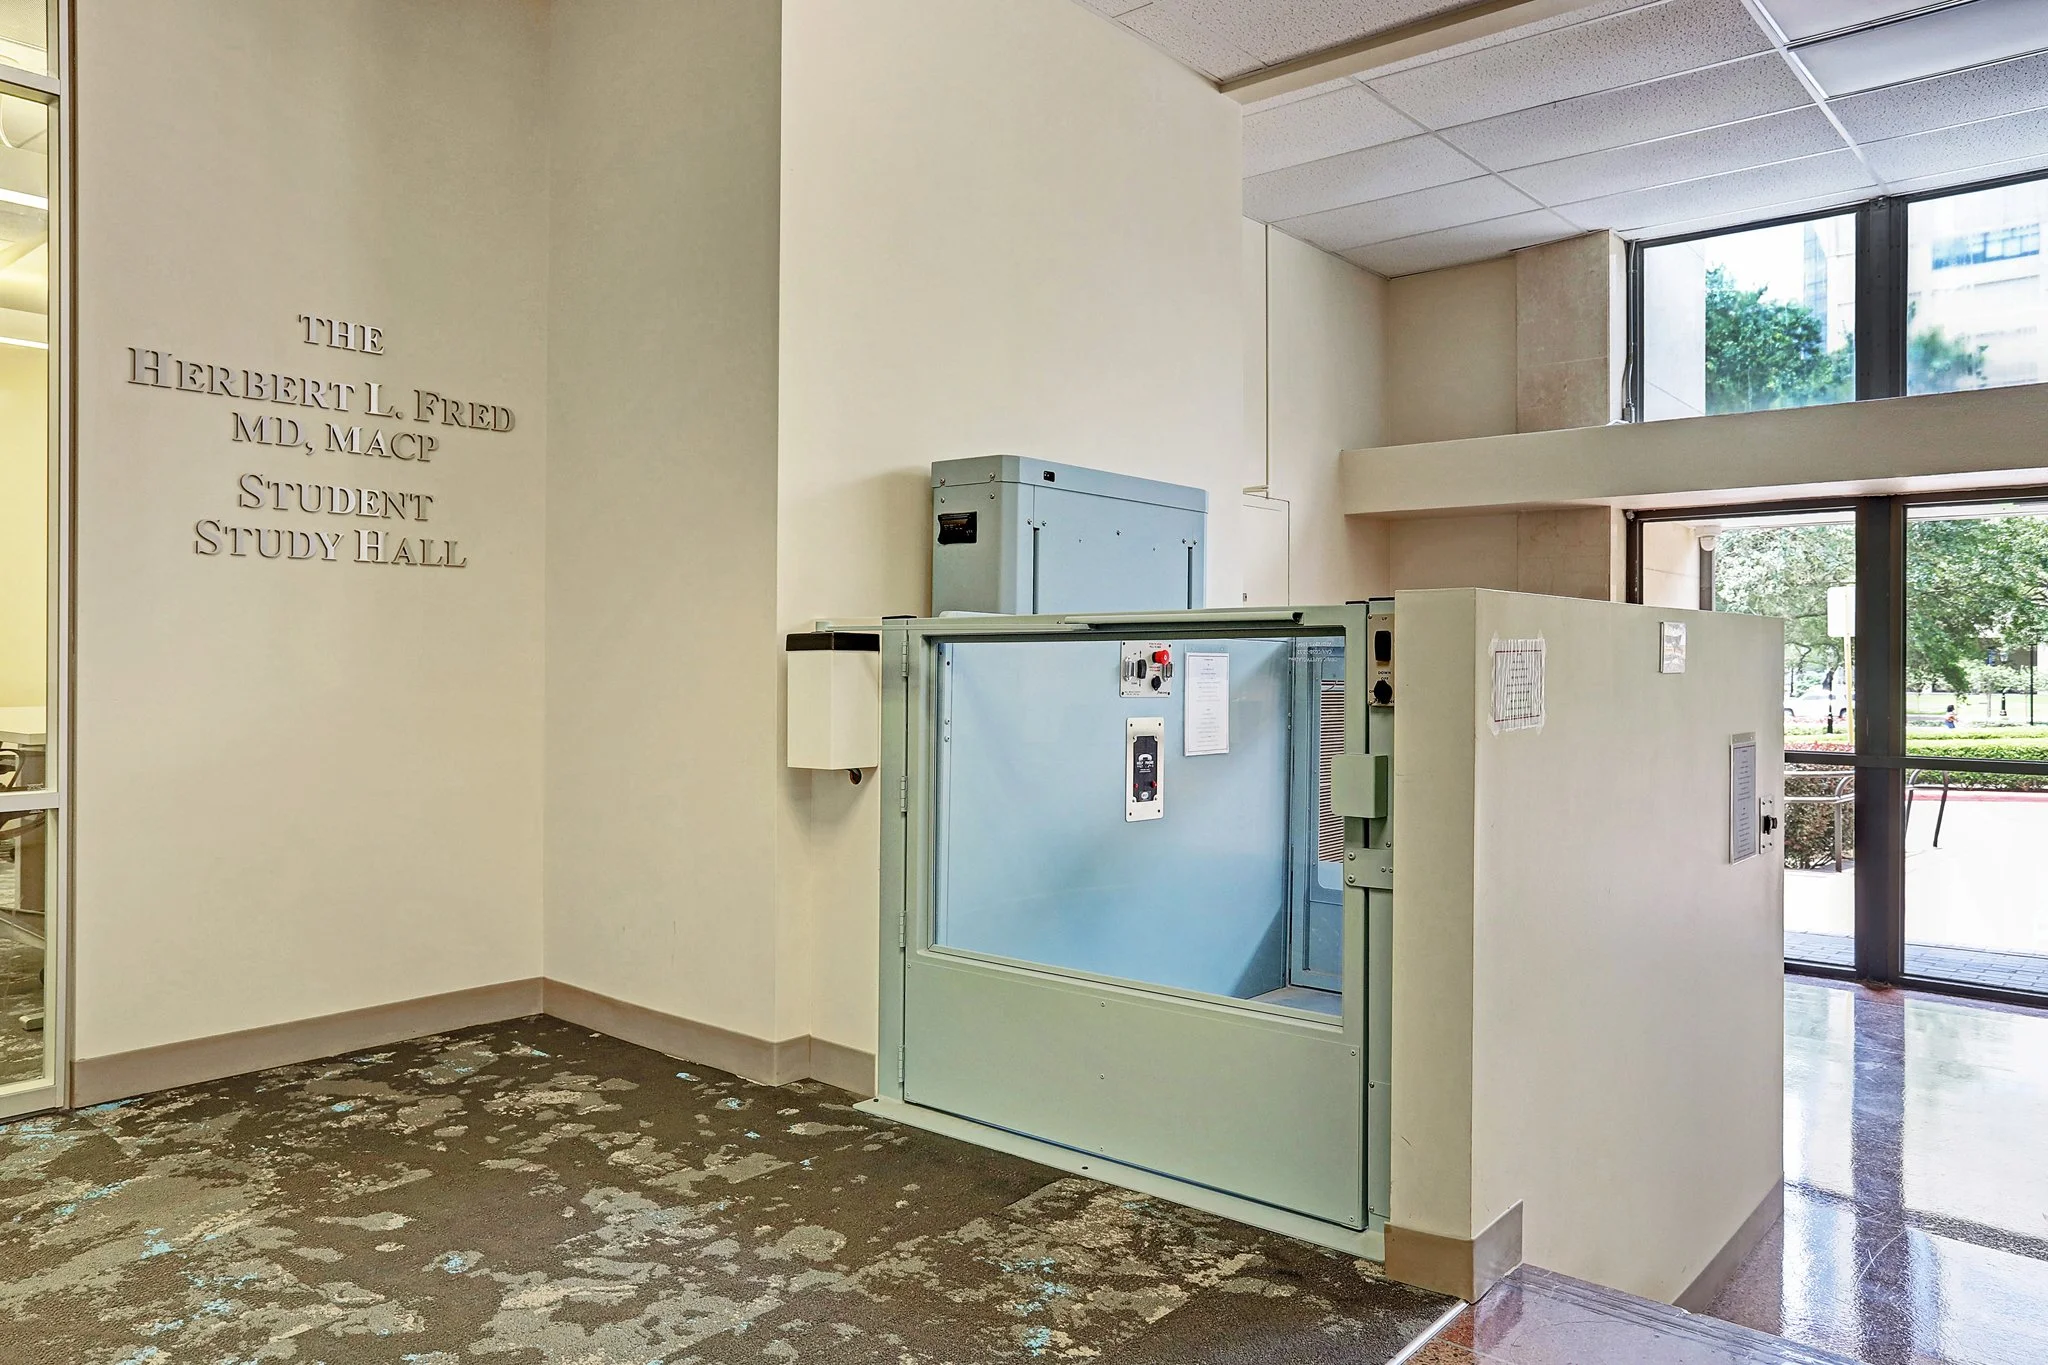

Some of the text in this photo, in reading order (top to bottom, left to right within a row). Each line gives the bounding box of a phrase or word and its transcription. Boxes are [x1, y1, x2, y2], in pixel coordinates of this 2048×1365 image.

[298, 313, 385, 356] THE
[127, 346, 516, 433] HERBERT L. FRED
[232, 411, 440, 463] MD, MACP
[238, 472, 434, 522] STUDENT
[194, 519, 468, 568] STUDY HALL
